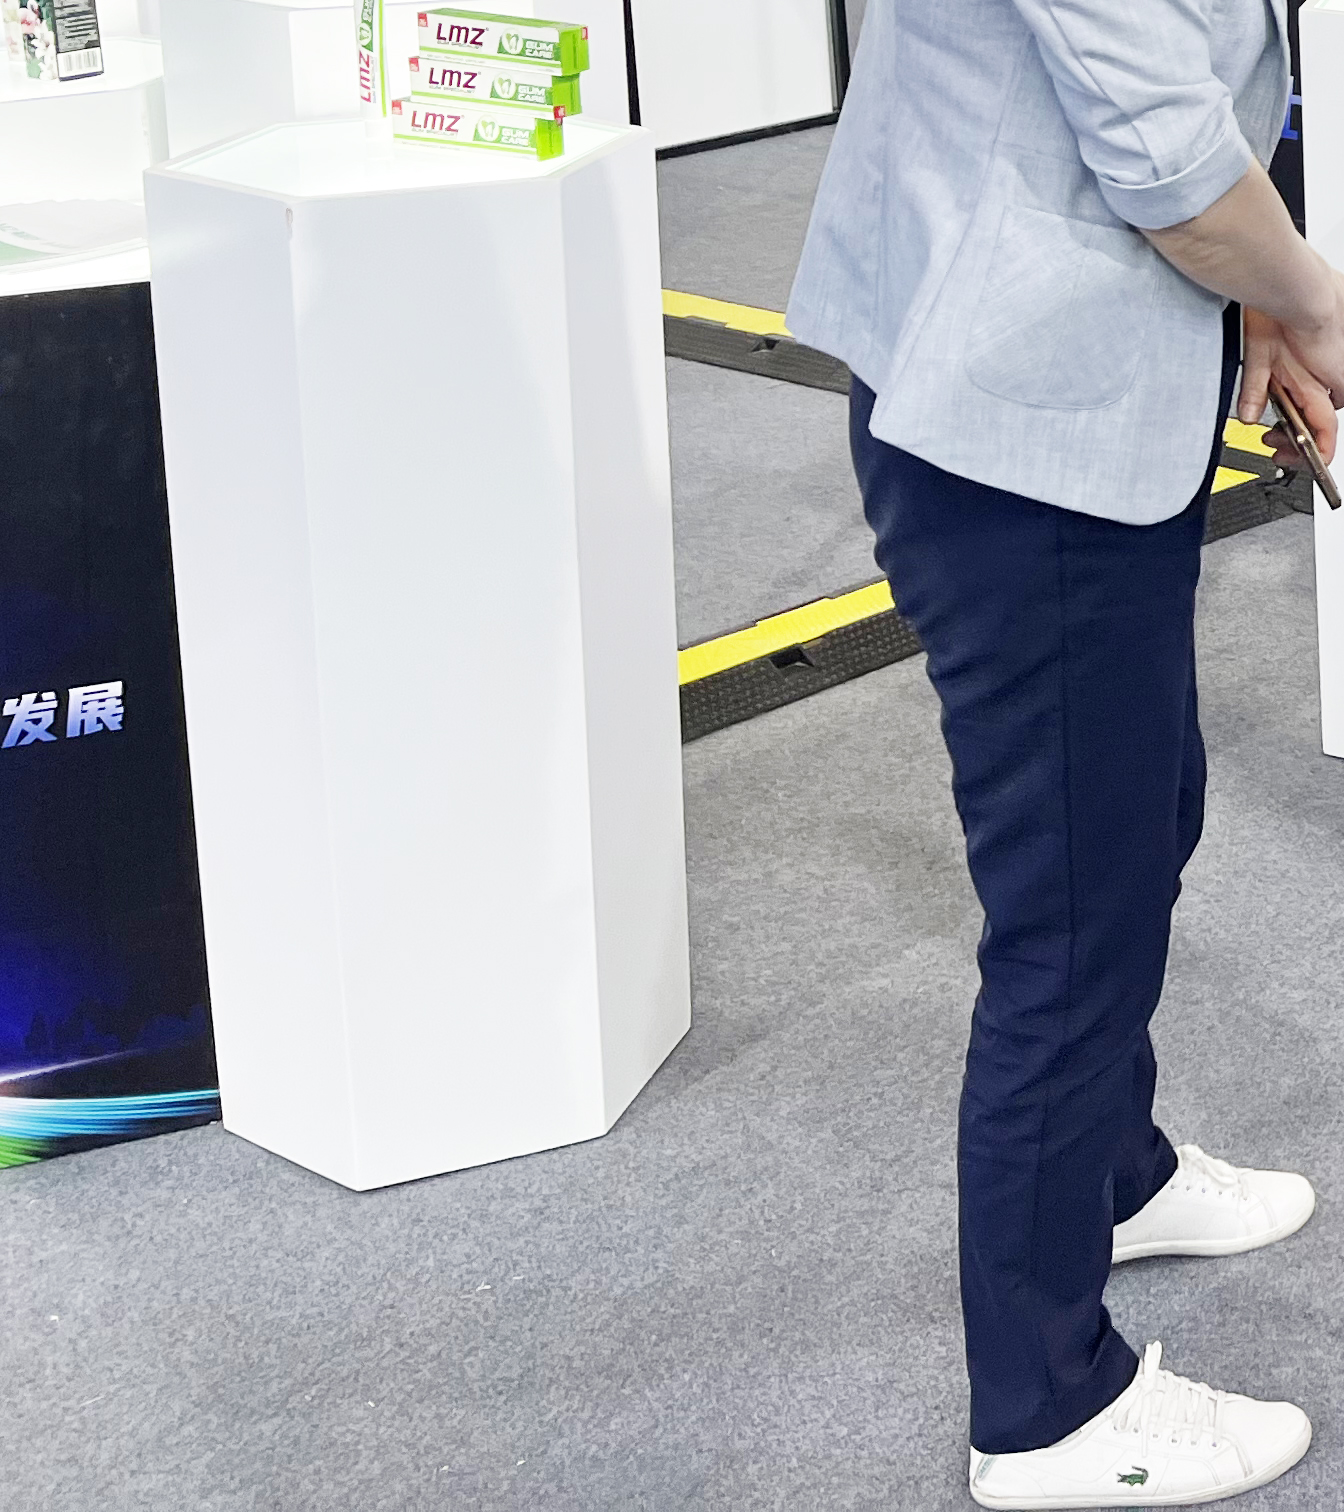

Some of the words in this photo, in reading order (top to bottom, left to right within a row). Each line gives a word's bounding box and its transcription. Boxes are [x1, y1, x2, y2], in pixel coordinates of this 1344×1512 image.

[436, 23, 486, 47] LMZ
[428, 67, 479, 89] LMZ
[411, 110, 461, 133] LMZ
[1, 680, 125, 749] 发展
